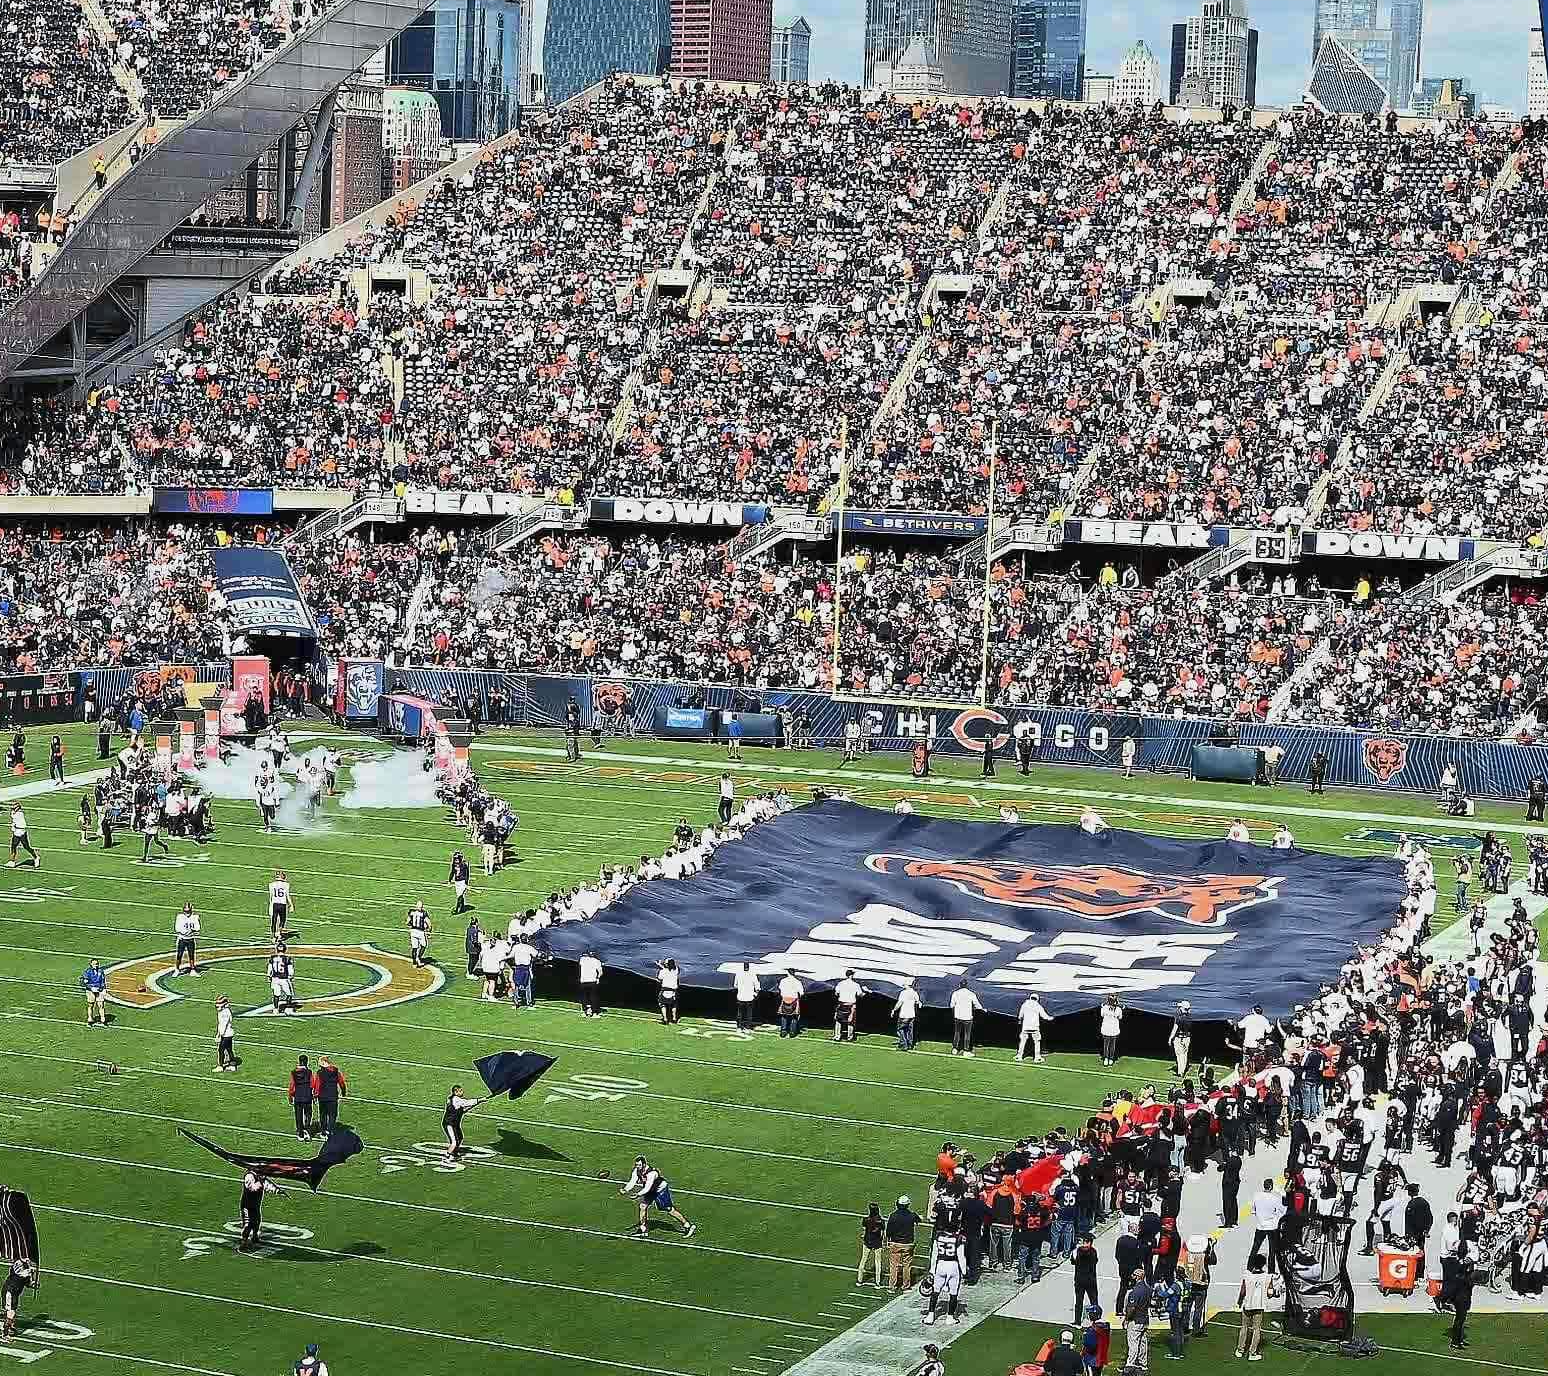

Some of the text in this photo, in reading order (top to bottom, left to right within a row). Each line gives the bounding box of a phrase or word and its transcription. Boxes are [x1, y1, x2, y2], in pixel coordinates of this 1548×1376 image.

[408, 492, 520, 515] BEAR
[612, 500, 742, 525] DOWN
[882, 518, 975, 532] BETRIVERS
[1081, 521, 1211, 547] BEAR
[1316, 532, 1460, 558] DOWN
[1223, 1105, 1239, 1118] 34
[1340, 1143, 1361, 1162] 56
[1388, 1258, 1408, 1279] G
